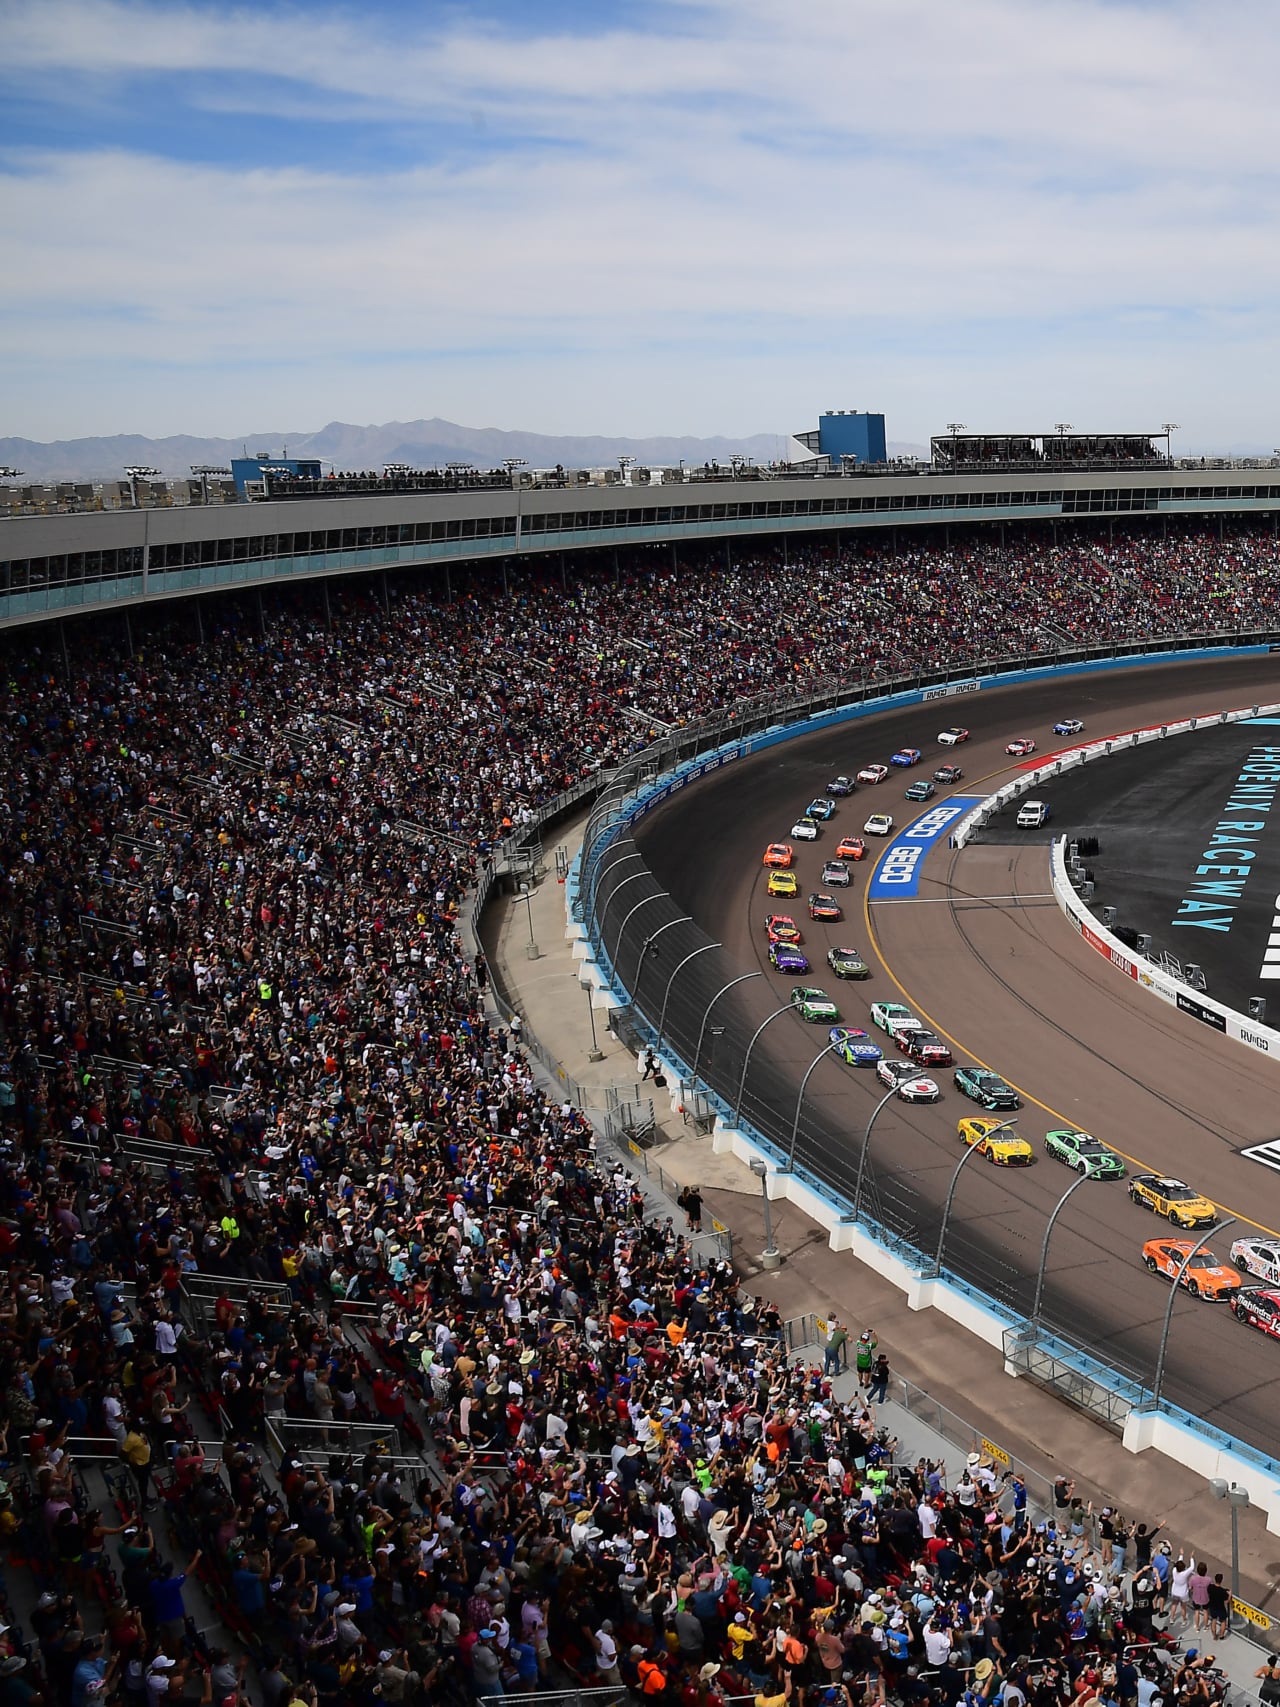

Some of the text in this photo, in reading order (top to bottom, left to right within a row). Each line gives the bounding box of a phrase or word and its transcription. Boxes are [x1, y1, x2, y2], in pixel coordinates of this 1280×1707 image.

[905, 807, 962, 838] GEICO
[879, 846, 923, 884] GEICO
[1171, 821, 1266, 932] RACEWAY
[1268, 1267, 1279, 1282] 48
